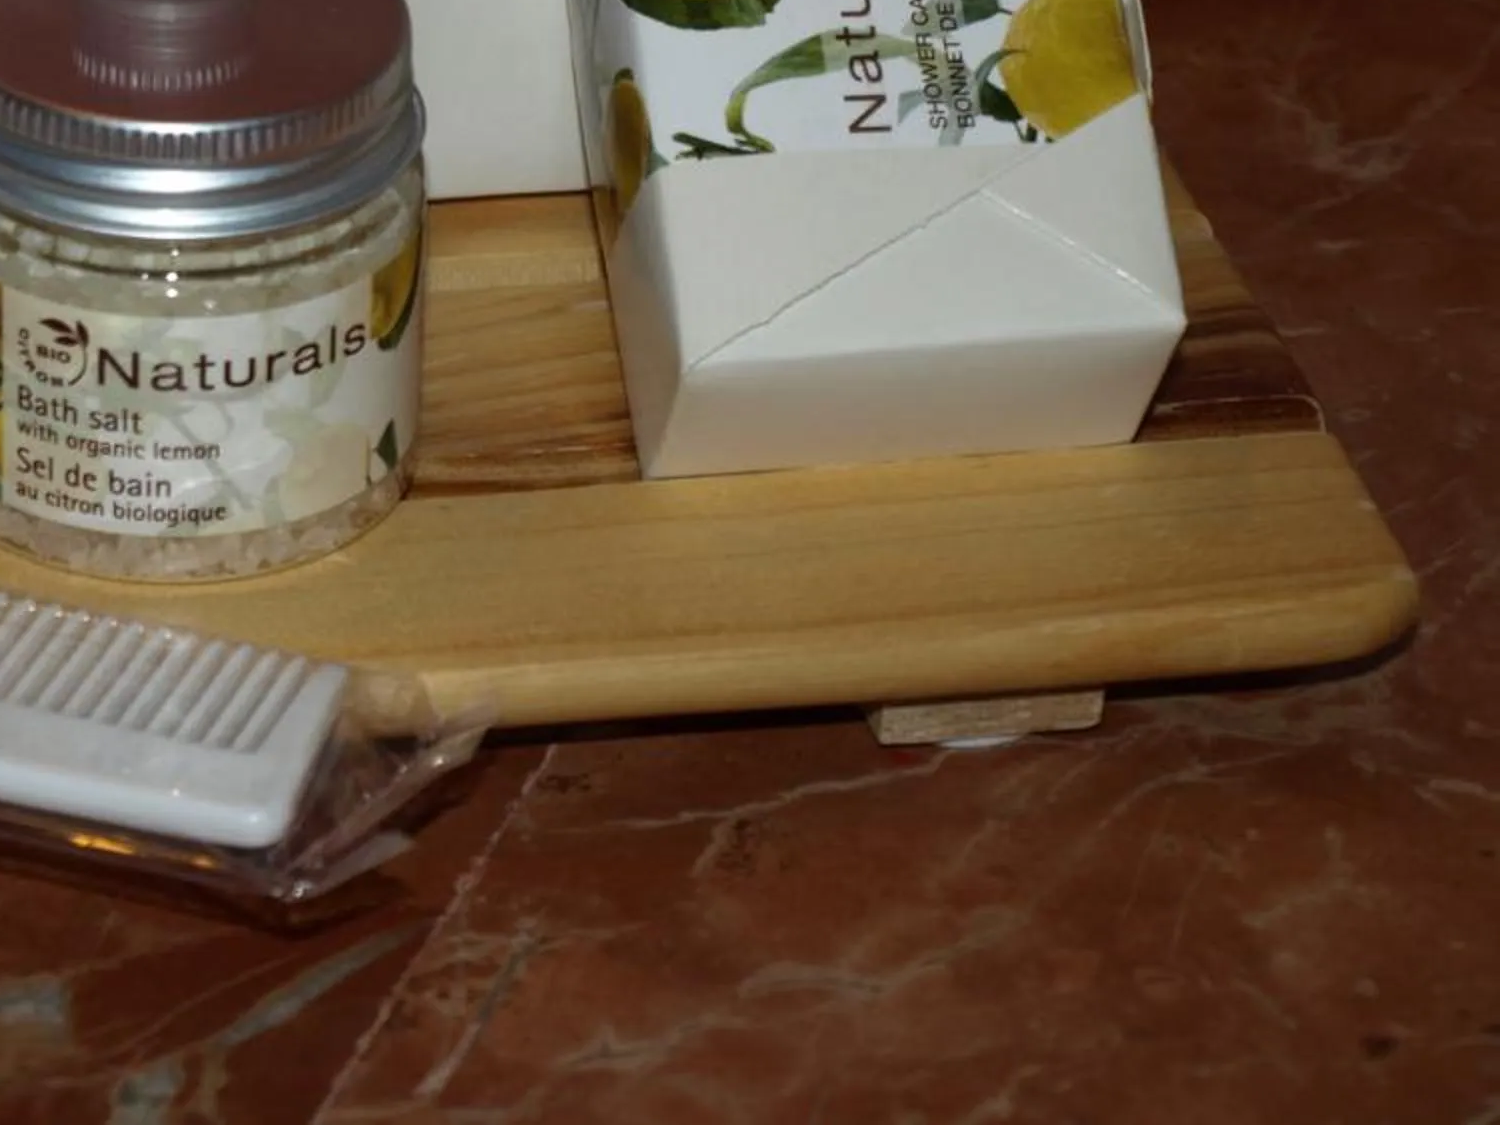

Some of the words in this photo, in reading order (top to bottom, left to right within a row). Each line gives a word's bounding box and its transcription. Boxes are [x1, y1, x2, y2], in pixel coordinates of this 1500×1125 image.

[936, 2, 958, 31] DE
[914, 31, 948, 130] SHOWER
[943, 38, 976, 129] BONNET
[35, 345, 72, 365] BIO
[98, 321, 367, 393] Naturals
[17, 384, 79, 426] Bath
[89, 407, 144, 435] salt
[17, 419, 59, 445] with
[65, 433, 145, 459] organic
[153, 441, 221, 460] lemon
[16, 447, 54, 481] Sel
[65, 463, 98, 492] de
[108, 469, 172, 498] bain
[15, 480, 39, 501] au
[45, 487, 105, 517] citron
[113, 500, 229, 528] biologique
